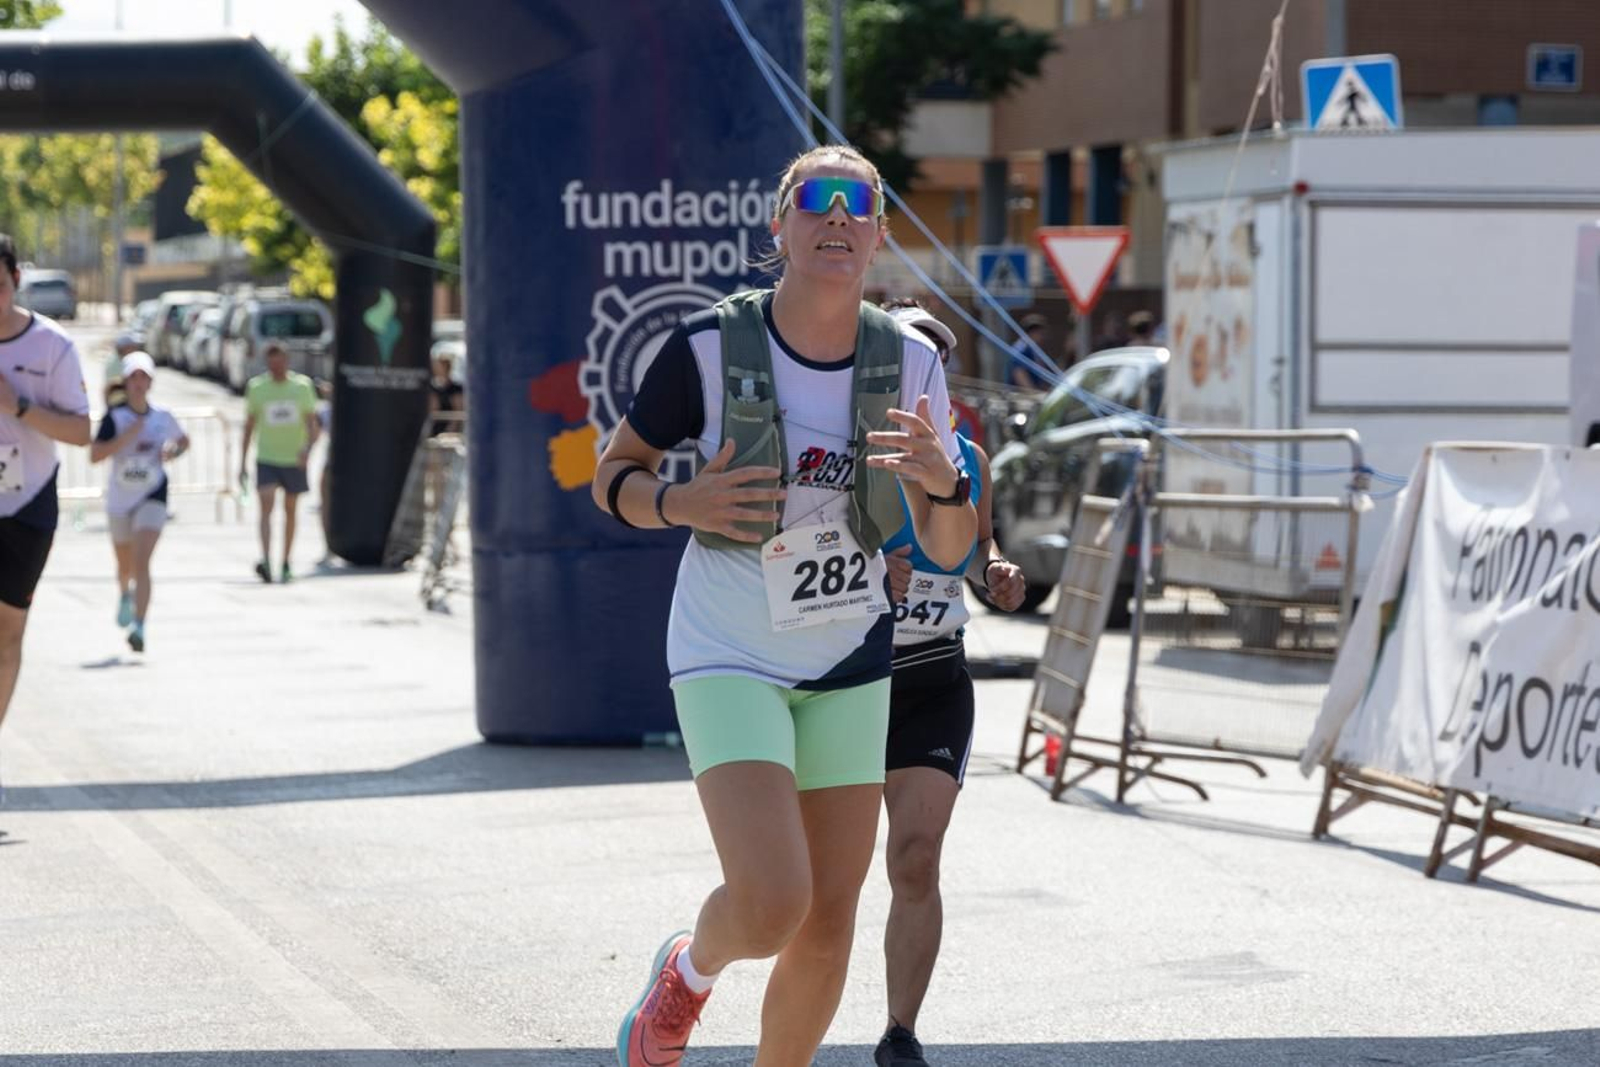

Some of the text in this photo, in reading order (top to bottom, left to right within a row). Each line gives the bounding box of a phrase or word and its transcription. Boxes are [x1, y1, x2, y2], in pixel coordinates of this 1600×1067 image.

[604, 228, 749, 284] mupol
[791, 551, 869, 602] 282
[798, 602, 822, 614] CARMEN
[823, 599, 848, 610] HURTADO
